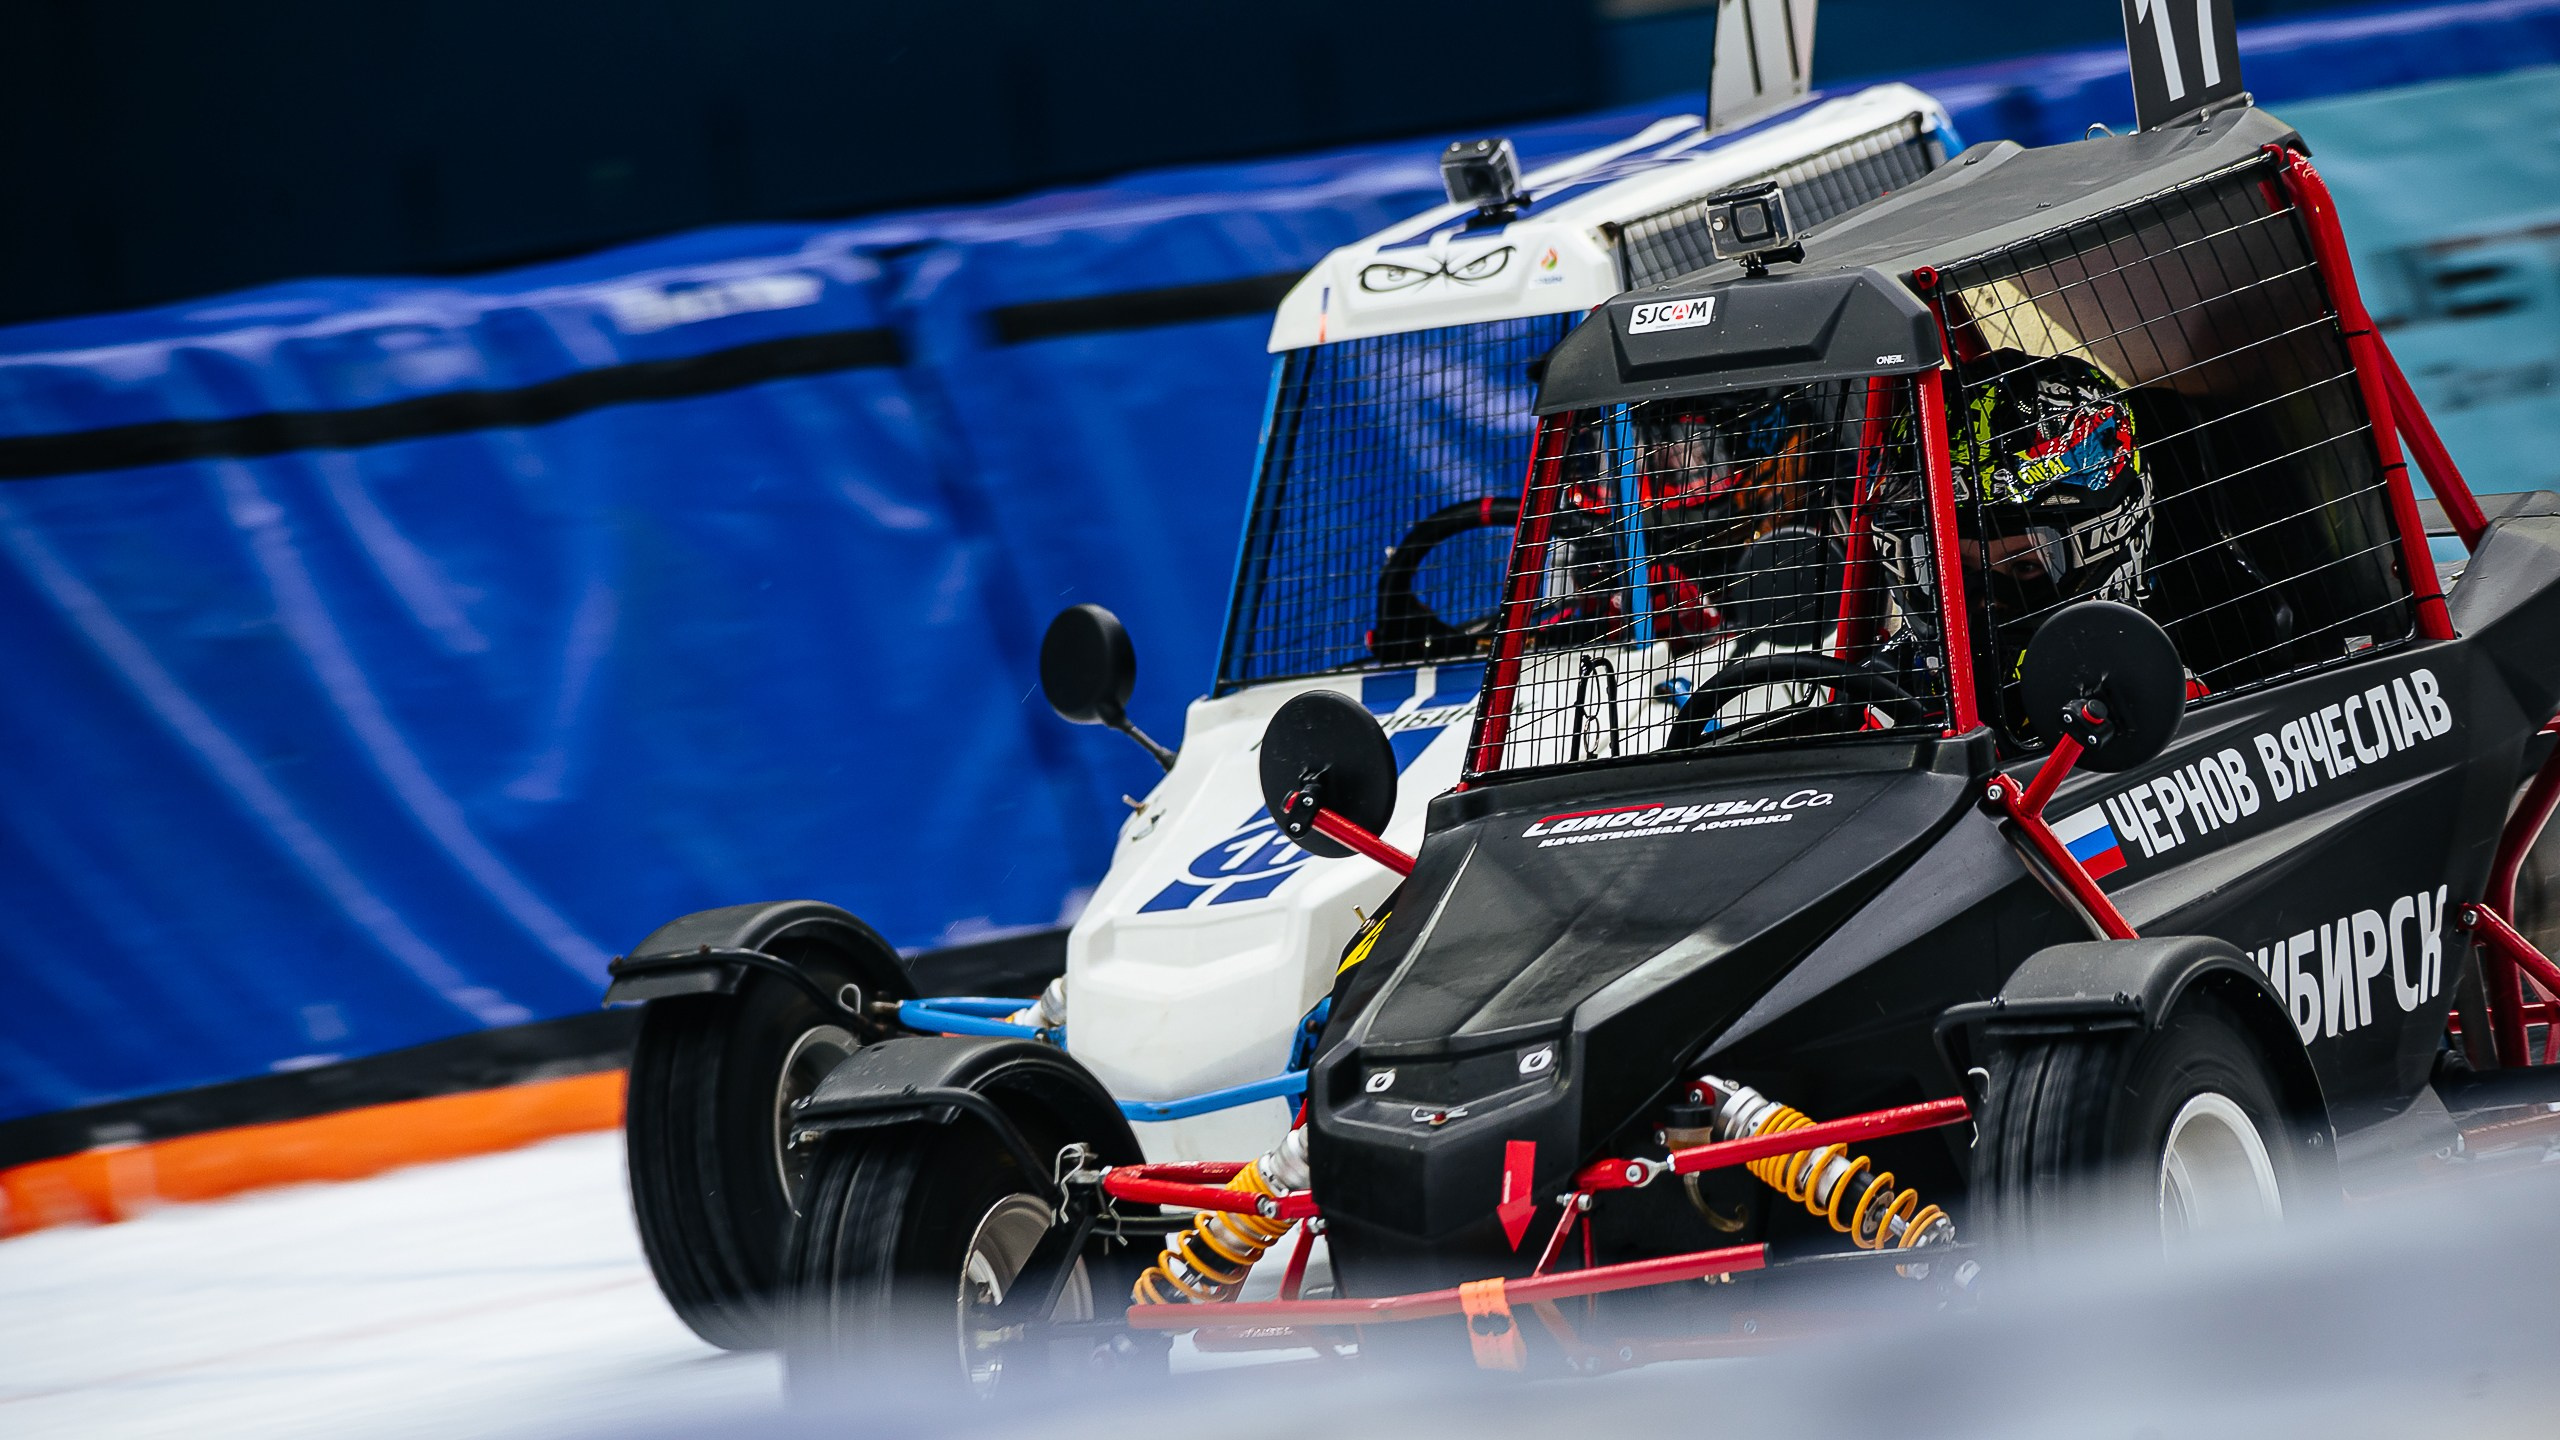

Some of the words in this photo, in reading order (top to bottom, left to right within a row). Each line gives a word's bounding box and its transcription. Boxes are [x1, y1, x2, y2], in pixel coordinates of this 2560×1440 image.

[1635, 300, 1707, 326] SJCAM
[2106, 748, 2260, 858] ЧЕРНОВ
[2253, 668, 2452, 802] ВЯЧЕСЛАВ
[2246, 884, 2448, 1046] ИБИРСК
